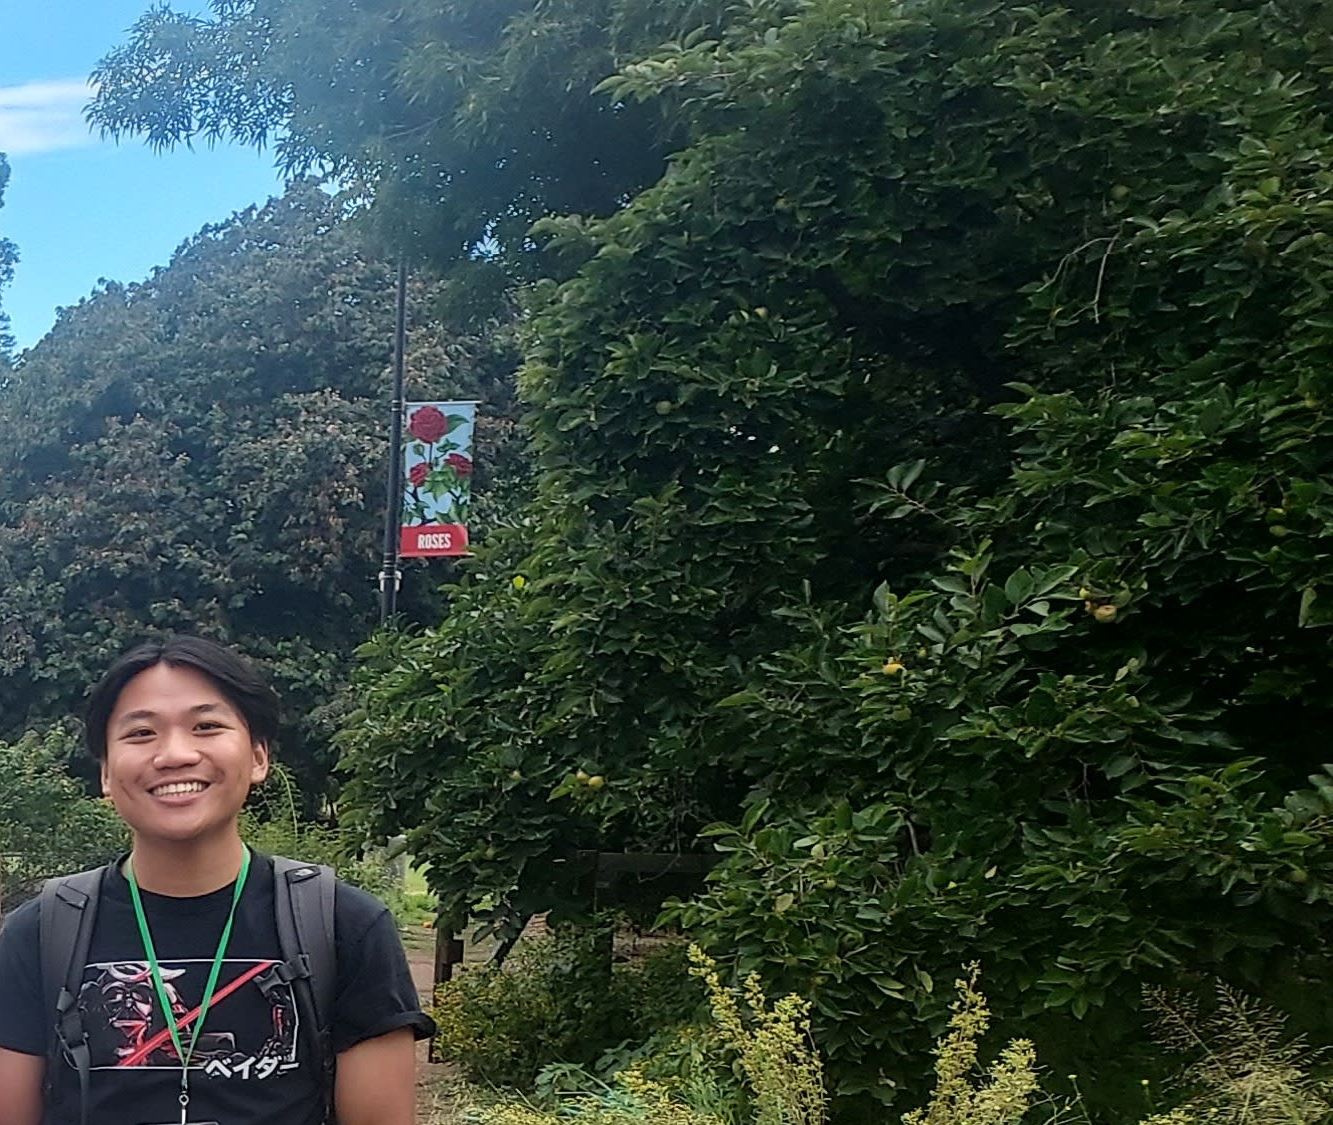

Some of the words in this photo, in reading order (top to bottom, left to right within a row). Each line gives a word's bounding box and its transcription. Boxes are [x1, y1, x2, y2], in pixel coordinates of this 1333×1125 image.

[417, 533, 451, 549] ROSES
[205, 1056, 300, 1079] ベイダー
